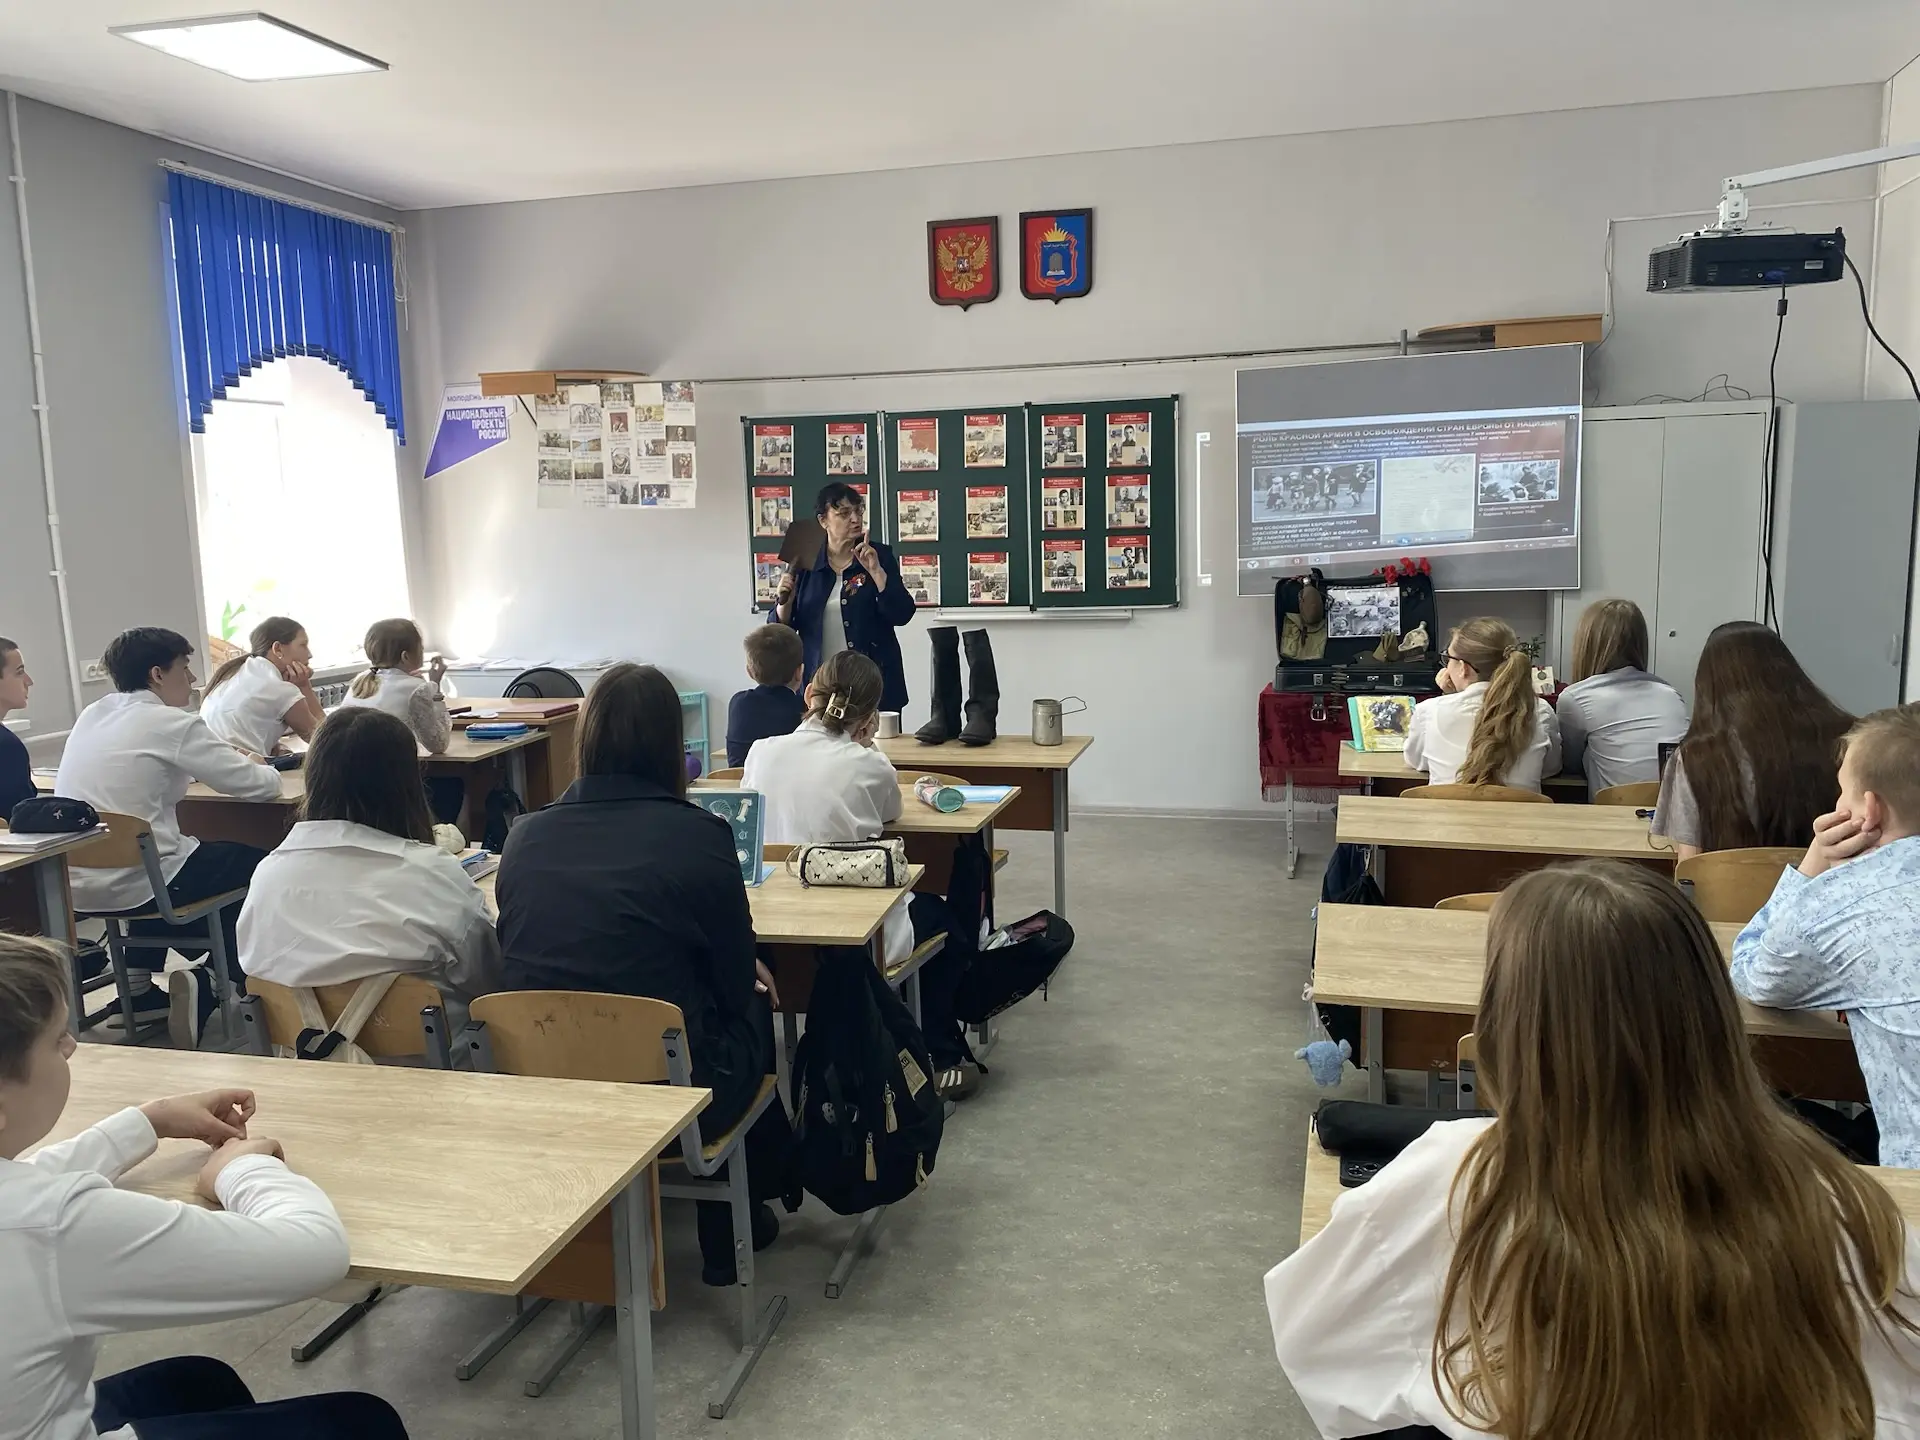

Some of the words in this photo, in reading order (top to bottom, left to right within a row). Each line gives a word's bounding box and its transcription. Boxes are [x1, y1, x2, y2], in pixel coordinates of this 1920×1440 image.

[446, 407, 505, 421] НАЦИОНАЛЬНЫЕ
[471, 418, 506, 430] ПРОЕКТЫ
[479, 428, 507, 440] РОССИИ
[1253, 435, 1278, 443] РОЛЬ
[1279, 433, 1321, 441] КРАСНОЙ
[1322, 430, 1353, 439] АРМИИ
[1362, 426, 1436, 436] ОСВОБОЖДЕНИИ
[1437, 423, 1465, 432] СТРАН
[1466, 422, 1503, 430] ЕВРОПЫ
[1504, 421, 1515, 429] ОТ
[1517, 420, 1557, 428] НАЦИЗМА
